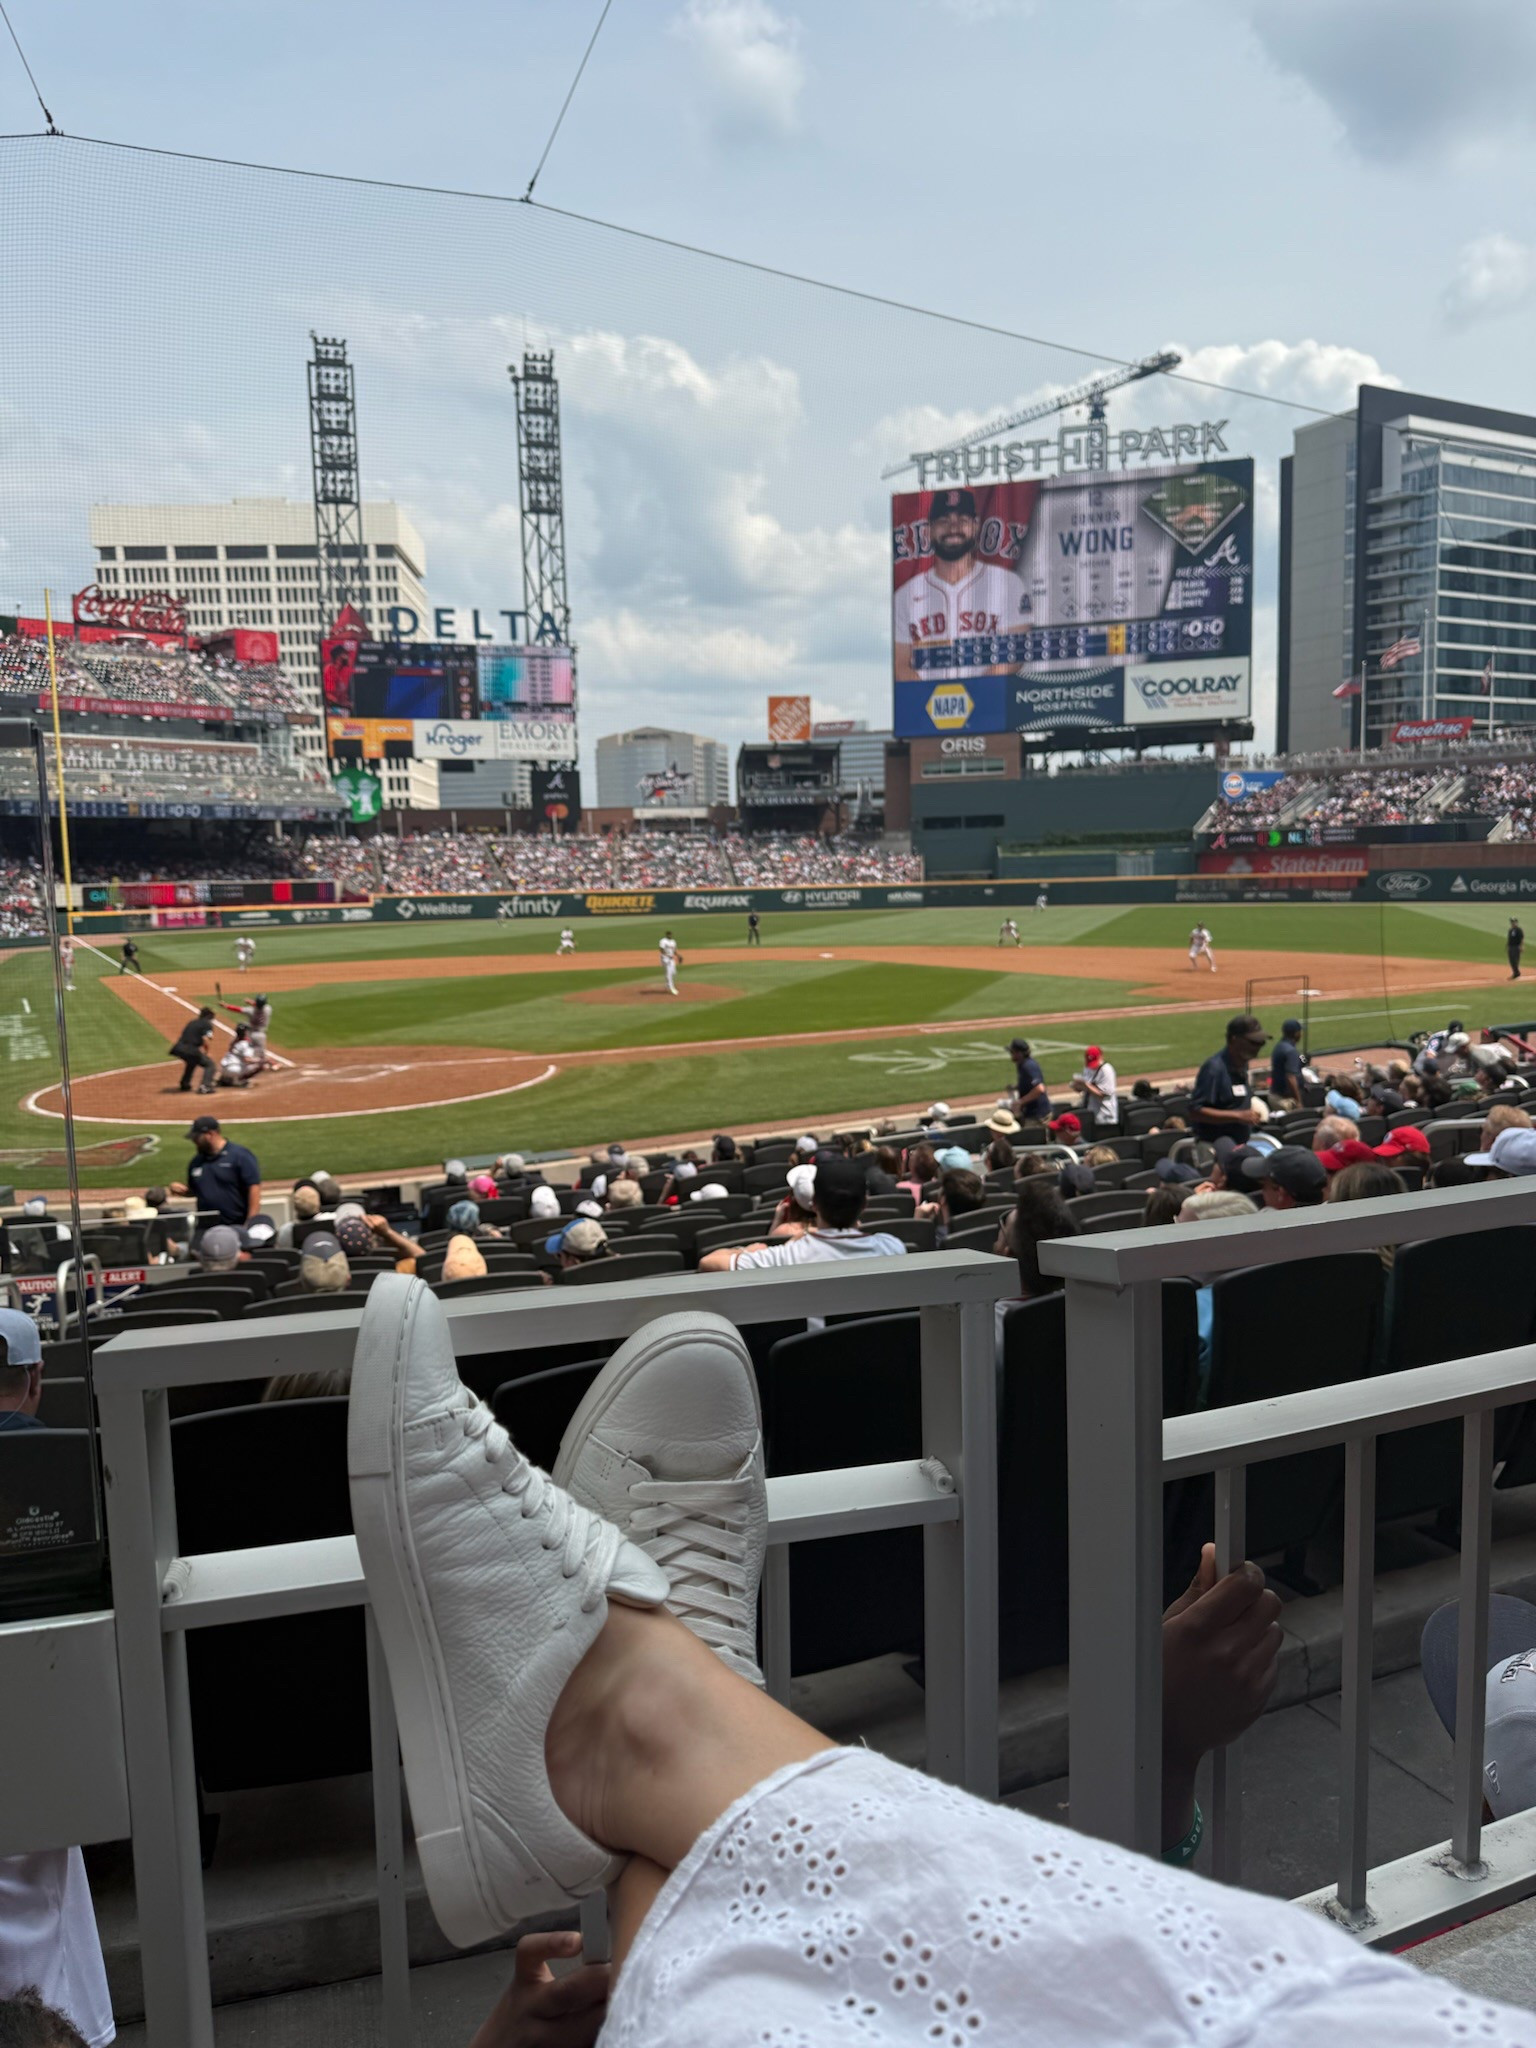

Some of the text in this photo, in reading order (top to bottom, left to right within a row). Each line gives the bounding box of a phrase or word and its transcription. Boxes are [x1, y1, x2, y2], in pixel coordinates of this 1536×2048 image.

[910, 420, 1230, 482] TRUIST PARK
[1058, 526, 1133, 556] WONG
[390, 606, 562, 642] DELTA
[909, 611, 1000, 641] RED SOX
[1189, 620, 1203, 637] 0
[1210, 618, 1225, 635] 0
[1016, 684, 1116, 704] NORTHSIDE
[1142, 674, 1242, 697] COOLRAY
[934, 697, 966, 716] NAPA
[1033, 701, 1097, 712] HOSPITAL
[500, 723, 570, 740] EMORY
[1396, 722, 1463, 738] RaceTrac
[426, 723, 482, 755] Kroger
[941, 736, 985, 753] ORIS
[1386, 873, 1420, 890] Ford
[1470, 878, 1536, 895] Georgia Po
[586, 896, 655, 909] QUIKRETE
[684, 895, 751, 910] EQUIFAX
[805, 891, 861, 901] HYUNDAI
[417, 903, 473, 915] Wellstar
[499, 895, 561, 918] xfinity
[109, 1271, 142, 1284] ALERT
